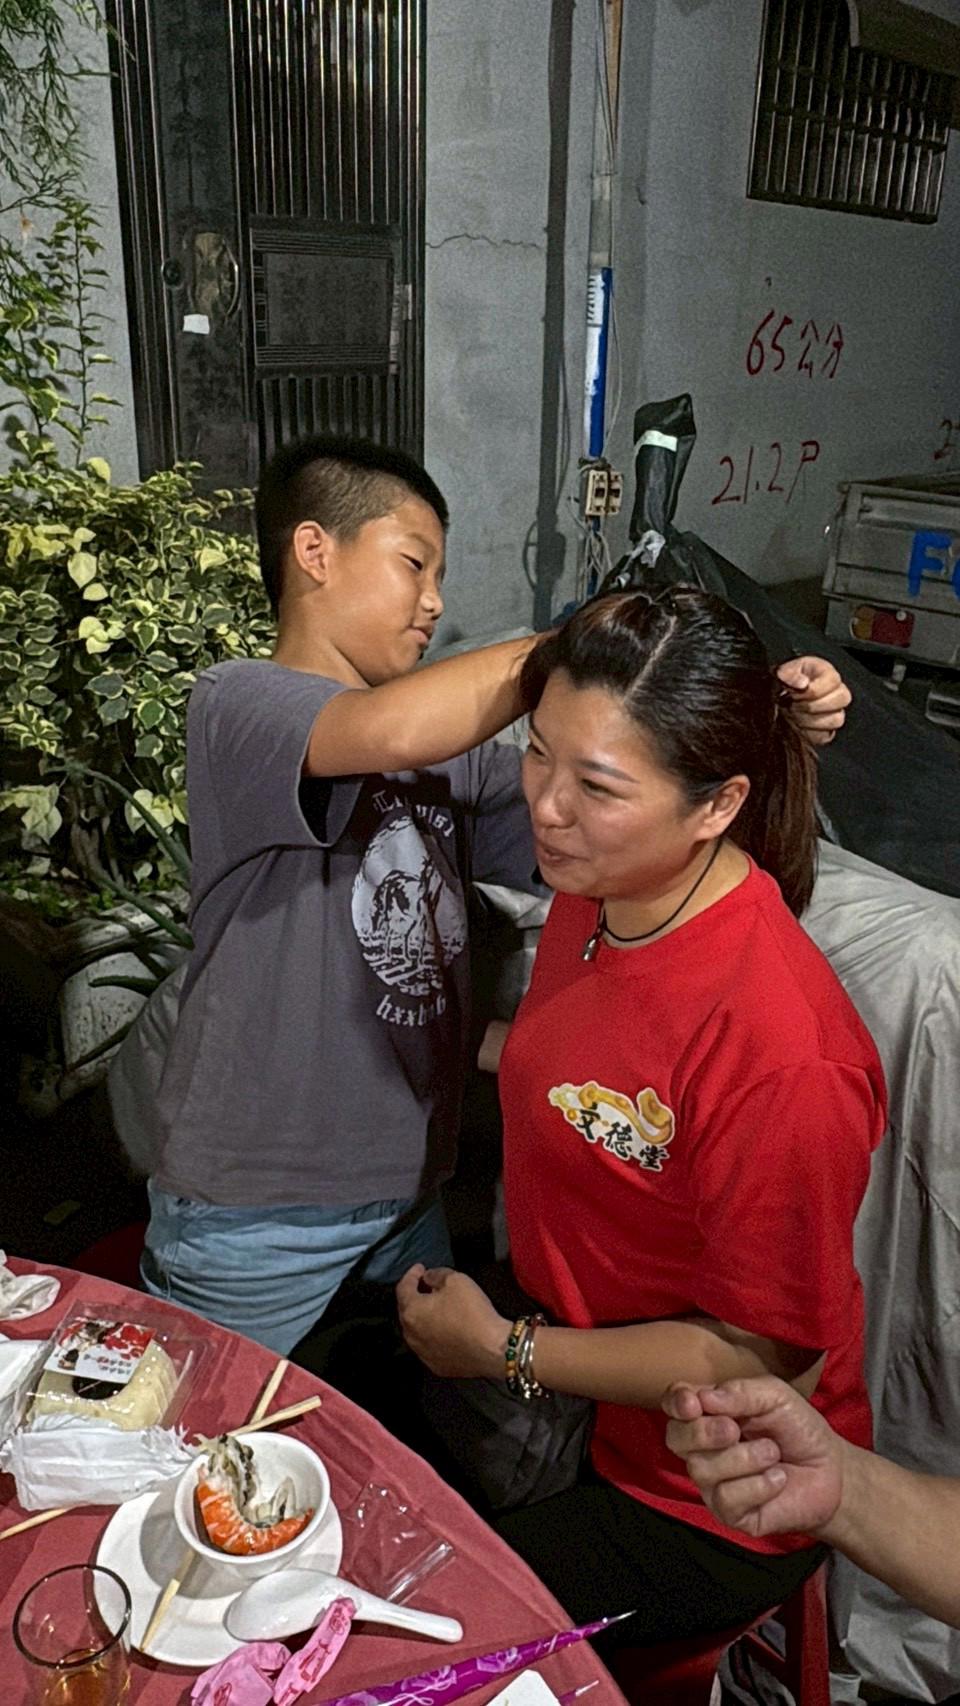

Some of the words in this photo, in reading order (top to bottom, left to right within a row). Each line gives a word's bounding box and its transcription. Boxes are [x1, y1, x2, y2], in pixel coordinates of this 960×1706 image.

[907, 529, 960, 597] F
[576, 1102, 669, 1170] 文德堂
